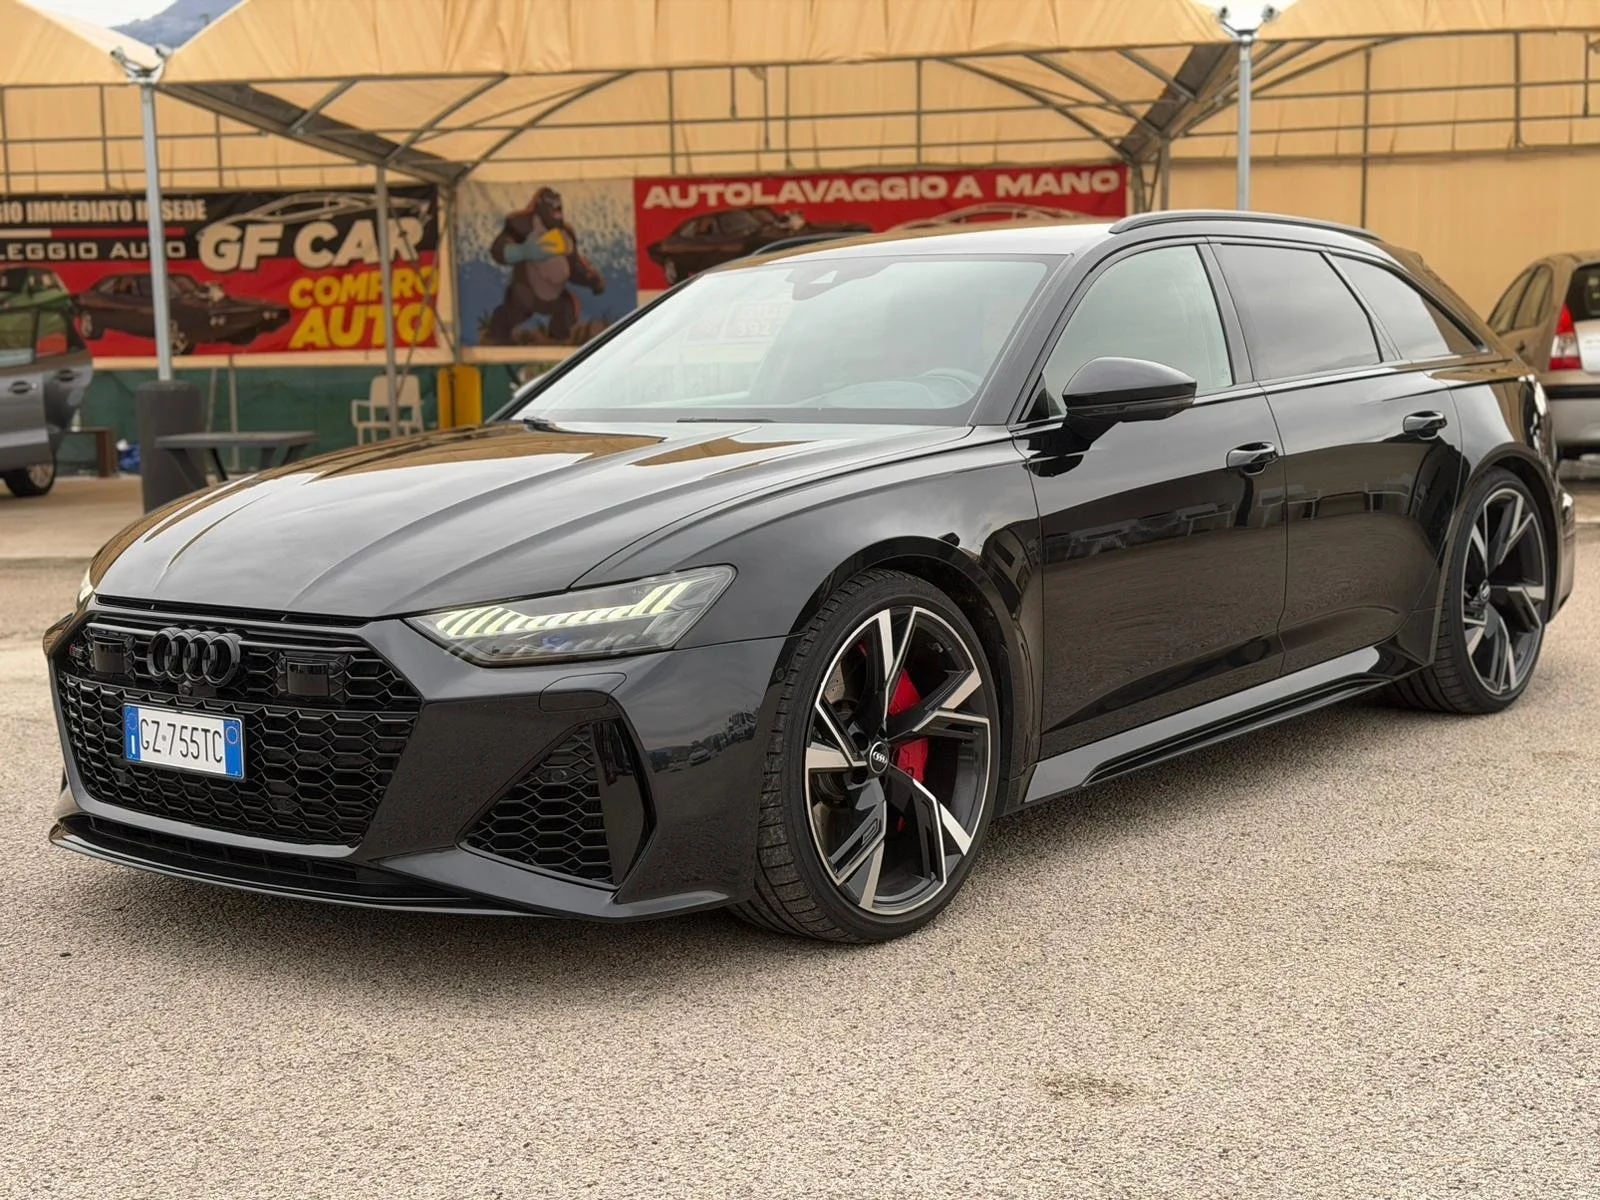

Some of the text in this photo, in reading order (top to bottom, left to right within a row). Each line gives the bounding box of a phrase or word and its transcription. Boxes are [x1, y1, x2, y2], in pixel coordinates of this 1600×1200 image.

[643, 170, 1120, 209] AUTOLAVAGGIO A MANO
[26, 200, 134, 222] IMMEDIATO
[161, 200, 207, 221] SEDE
[110, 241, 186, 259] AUO
[198, 216, 424, 272] GF CAR
[288, 265, 439, 349] COMPRO AUTO
